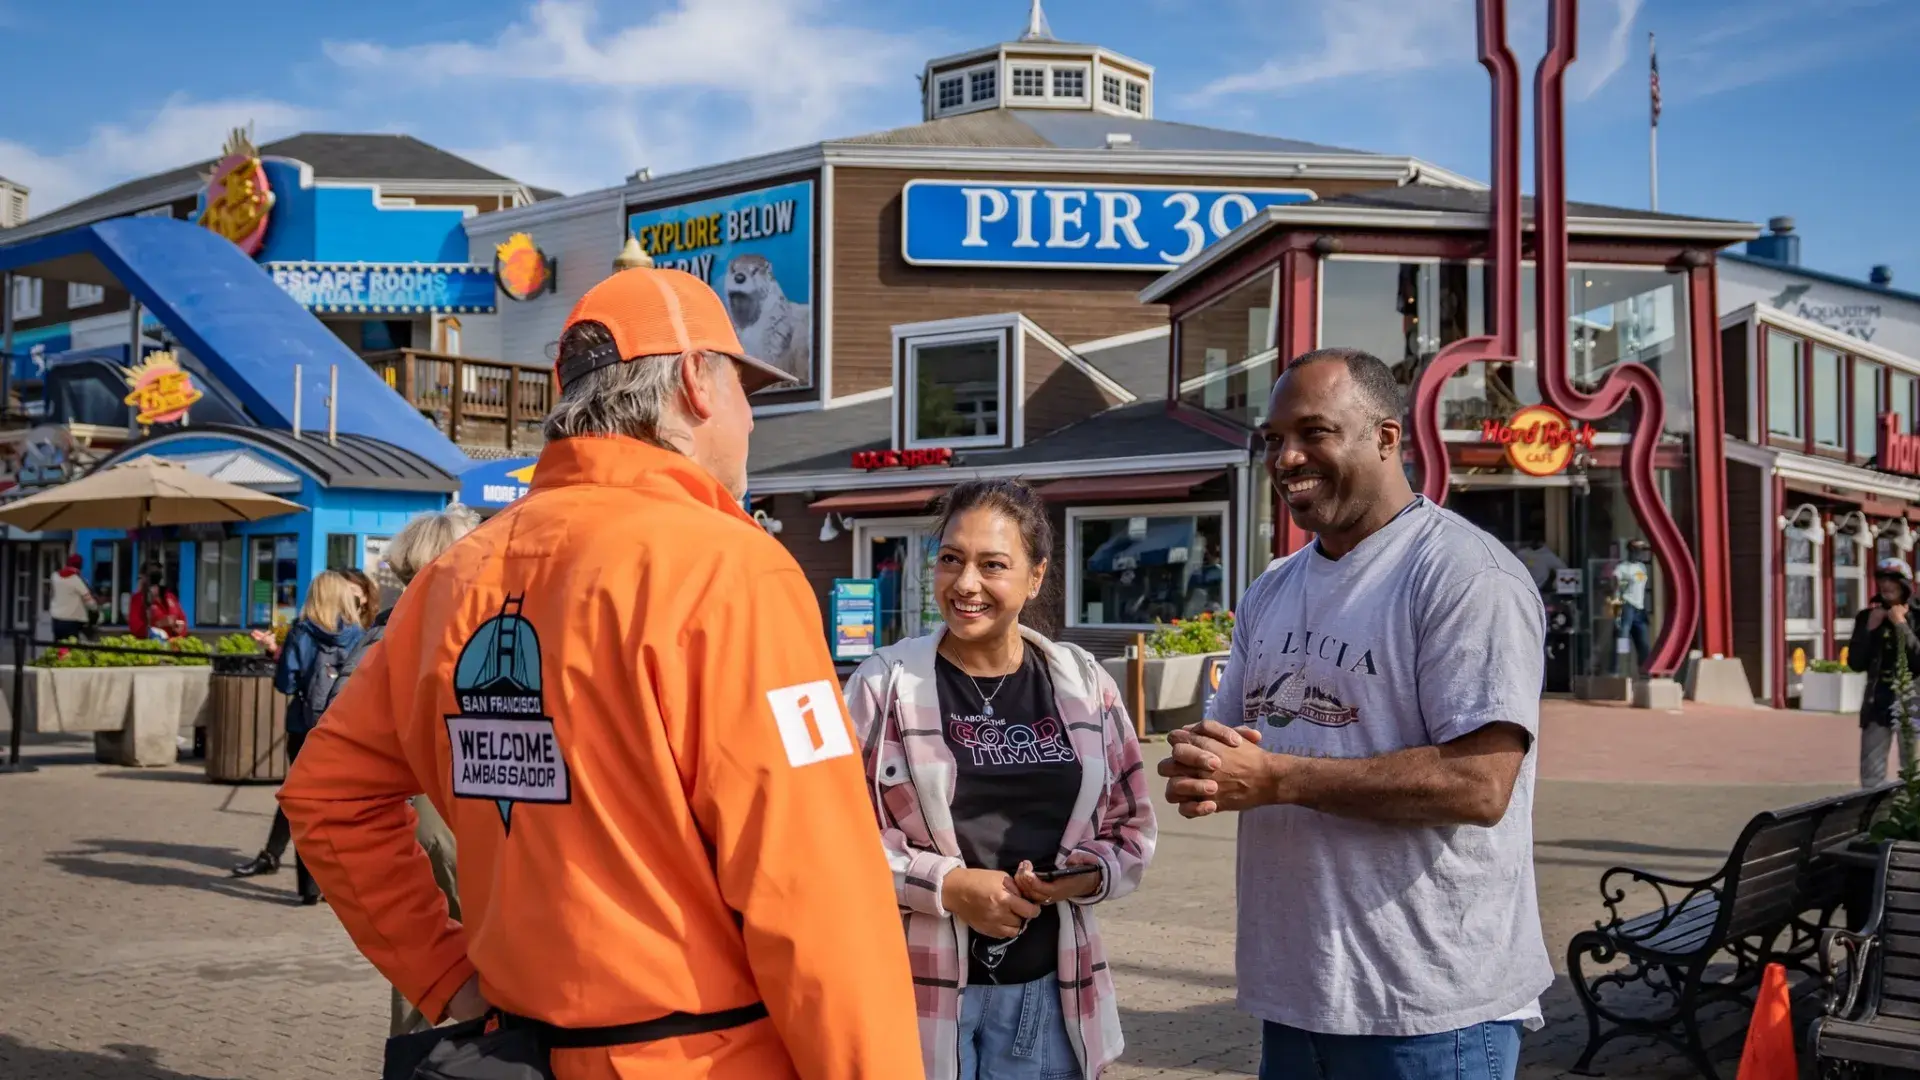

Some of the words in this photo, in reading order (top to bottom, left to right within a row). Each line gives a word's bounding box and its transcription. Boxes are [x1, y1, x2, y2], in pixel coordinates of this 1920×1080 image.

[640, 213, 722, 254] EXPLORE
[726, 200, 796, 242] BELOW
[961, 187, 1149, 250] PIER
[273, 271, 366, 292] ESCAPE
[369, 272, 448, 292] ROOMS
[1797, 302, 1881, 321] AQUARIUM
[1480, 419, 1541, 445] Hard
[1541, 420, 1598, 451] Rock
[901, 447, 952, 467] SHOP
[483, 484, 517, 503] MORE
[462, 695, 487, 713] SAN
[490, 696, 541, 714] FRANCISCO
[949, 716, 1060, 749] GOOD
[990, 717, 1007, 726] THE
[458, 729, 555, 764] WELCOME
[964, 733, 1076, 766] TIMES
[461, 763, 556, 788] AMBASSADOR
